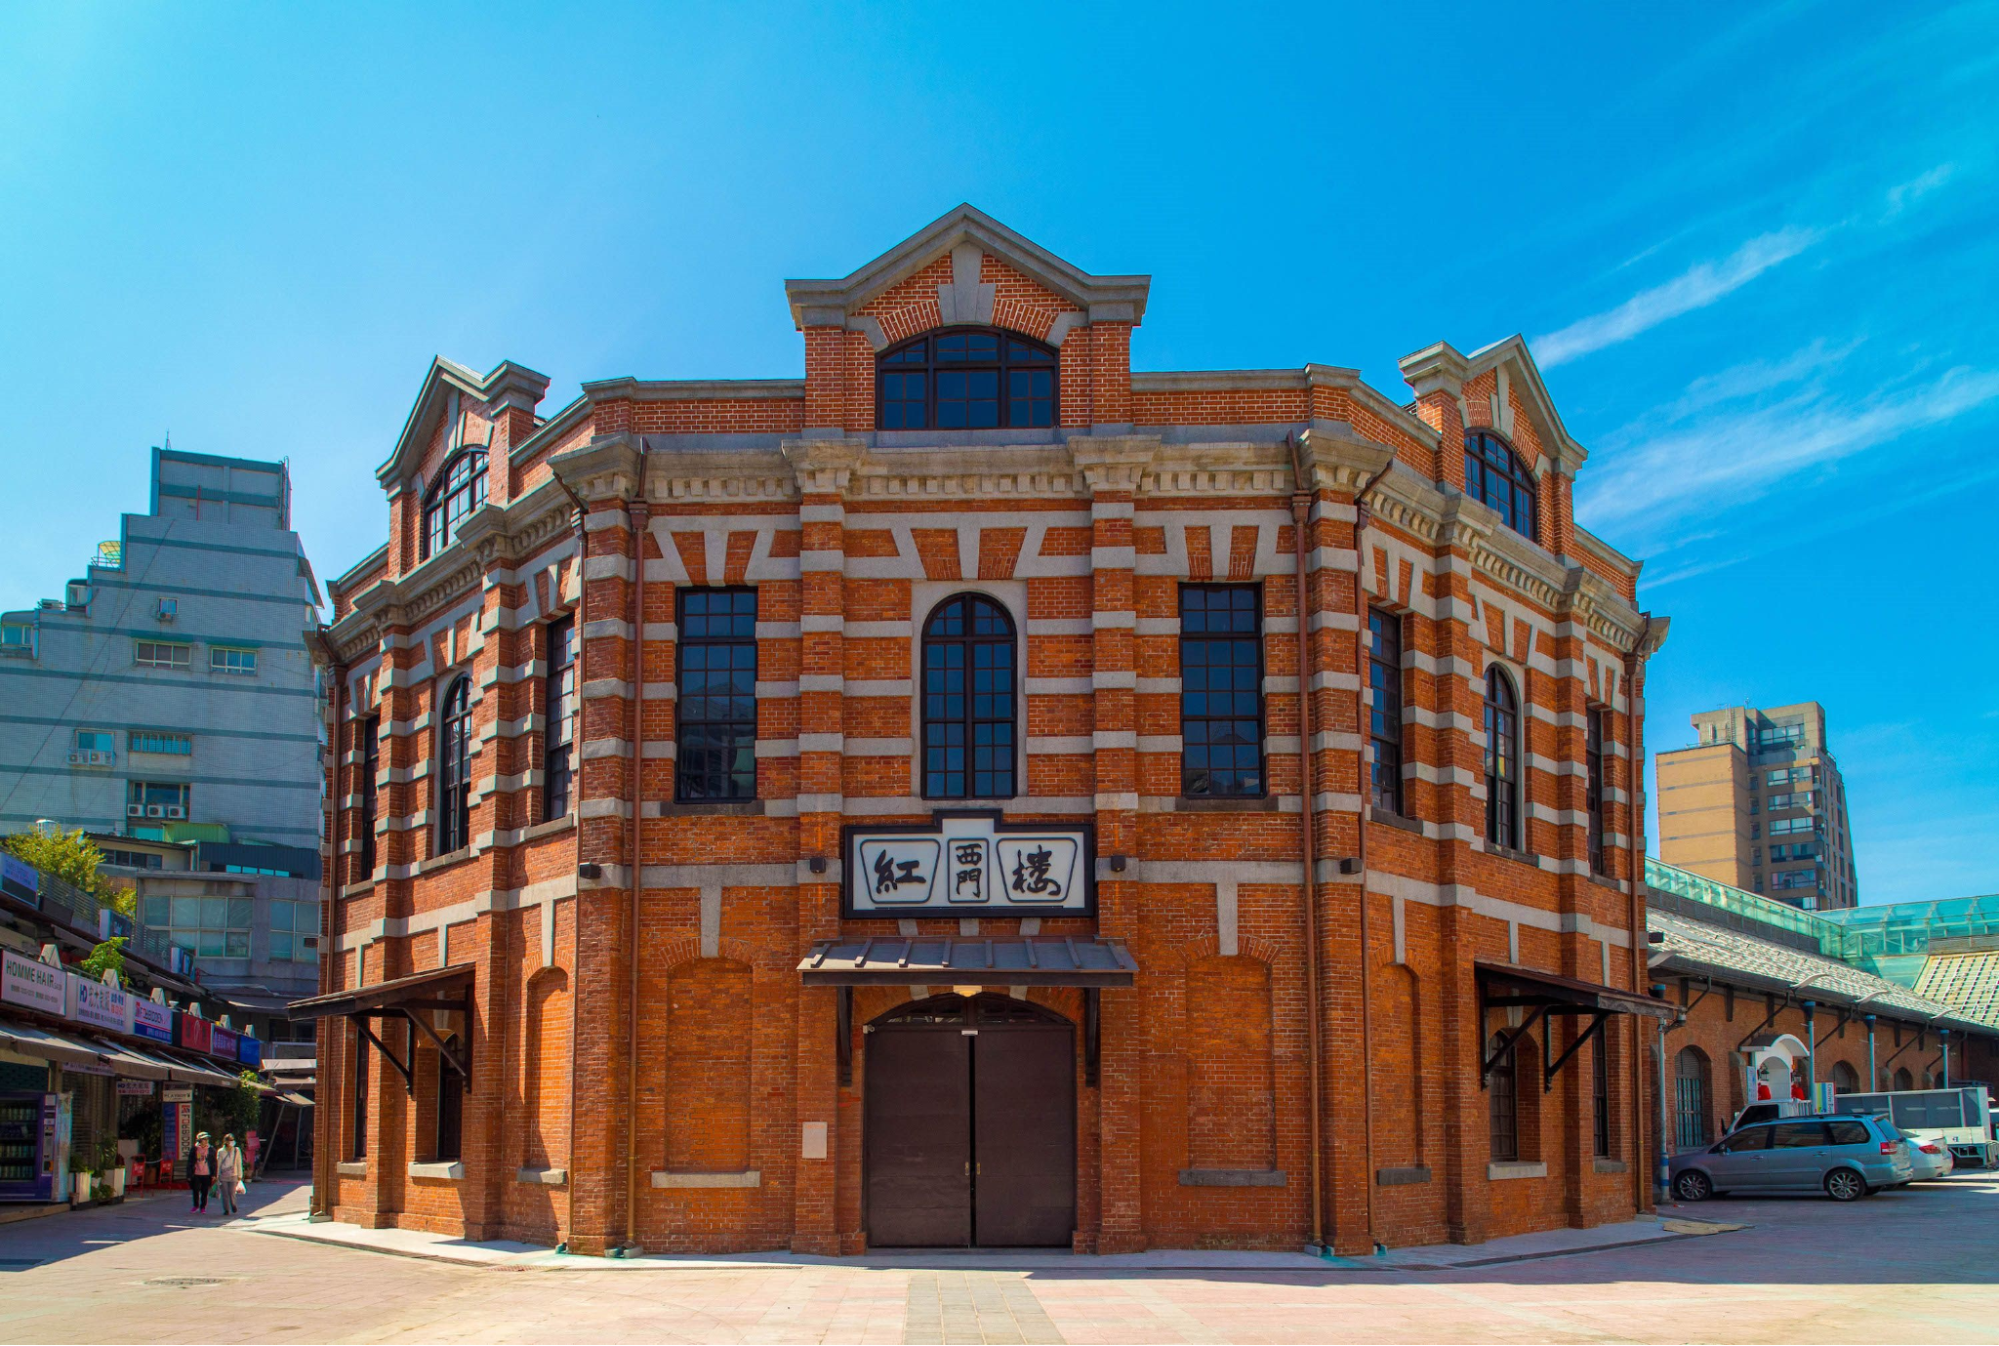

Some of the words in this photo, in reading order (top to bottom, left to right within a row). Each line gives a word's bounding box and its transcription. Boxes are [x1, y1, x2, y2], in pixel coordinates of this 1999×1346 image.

[874, 849, 927, 895] 紅
[955, 843, 983, 899] 西門
[1012, 844, 1062, 896] 樓
[6, 959, 36, 983] HOMME
[36, 970, 55, 988] HAIR
